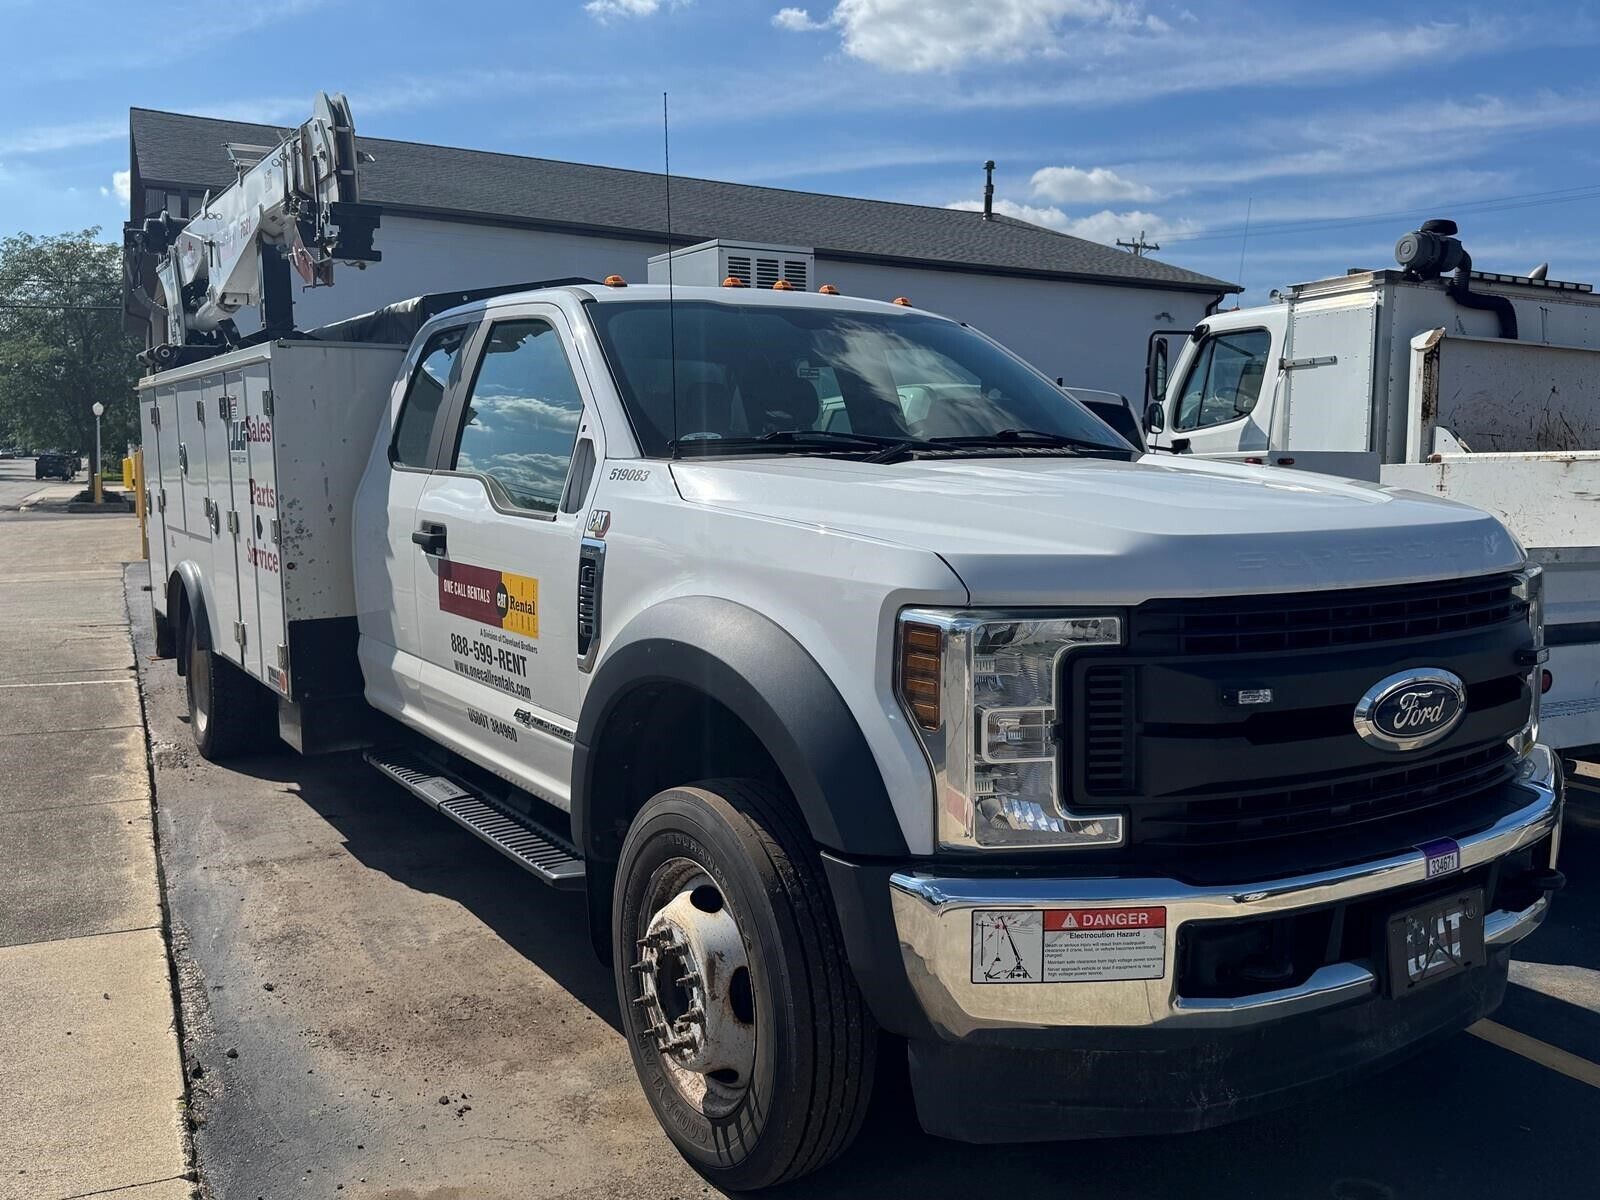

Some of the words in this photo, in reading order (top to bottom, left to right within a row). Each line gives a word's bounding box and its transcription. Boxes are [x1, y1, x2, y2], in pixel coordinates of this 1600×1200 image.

[246, 415, 271, 443] Sales
[609, 468, 650, 482] 519083
[249, 478, 275, 509] Parts
[589, 511, 608, 531] CAT
[247, 538, 279, 574] Service
[443, 579, 454, 594] ONE
[454, 582, 467, 598] CALL
[467, 585, 491, 604] RENTALS
[496, 592, 507, 609] CAT
[509, 595, 536, 616] Rental
[450, 632, 527, 678] 888-599-RENT
[453, 659, 532, 700] www.onecallrentals.com
[1393, 690, 1446, 729] Ford
[1431, 854, 1456, 875] 334671
[1082, 912, 1149, 927] DANGER
[1069, 931, 1115, 940] Electrocution
[1116, 930, 1141, 938] Hazard
